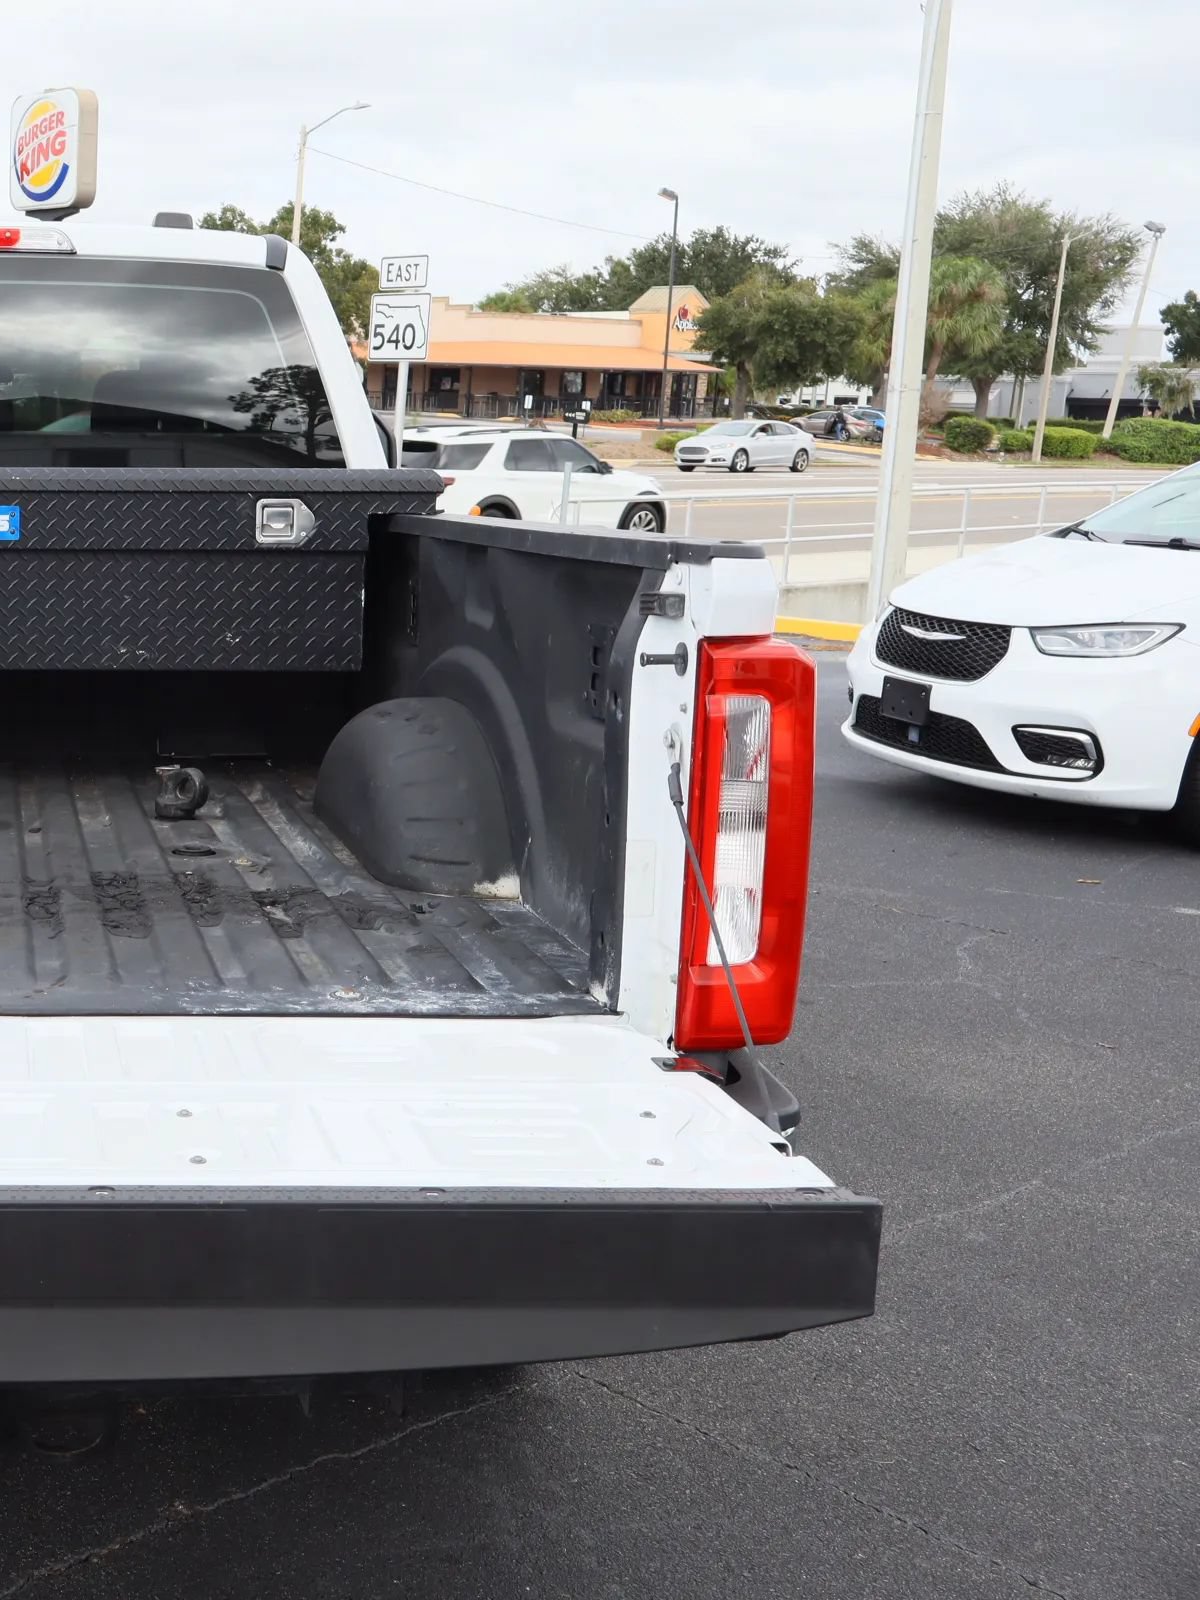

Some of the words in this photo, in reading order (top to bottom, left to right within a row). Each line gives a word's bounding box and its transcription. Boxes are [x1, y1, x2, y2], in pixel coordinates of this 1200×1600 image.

[17, 111, 65, 157] BURGER
[19, 130, 67, 184] KING
[386, 263, 420, 283] EAST
[372, 323, 416, 351] 540
